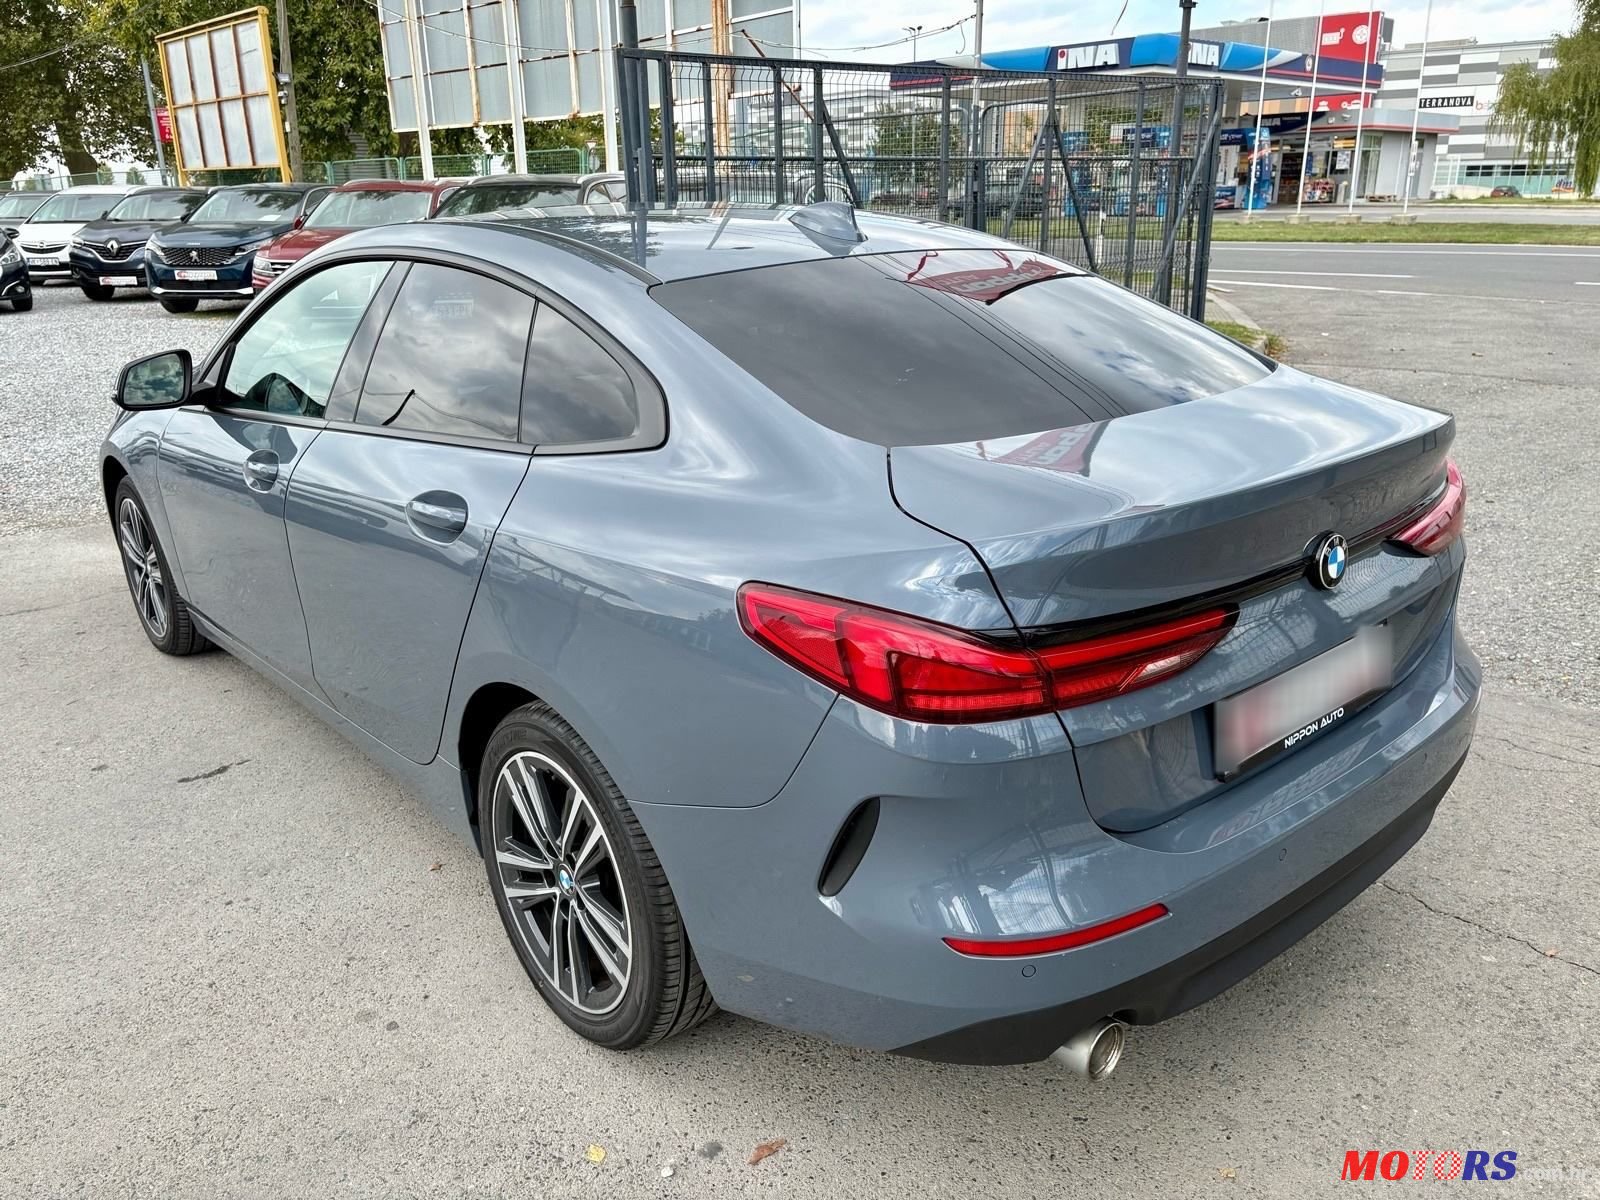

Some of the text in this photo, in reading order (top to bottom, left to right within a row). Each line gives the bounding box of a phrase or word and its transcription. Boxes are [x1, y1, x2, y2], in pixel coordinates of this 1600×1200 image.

[1057, 43, 1120, 70] INA
[1420, 97, 1472, 108] TERRANOVA
[1284, 707, 1345, 749] NIPPON AUTO
